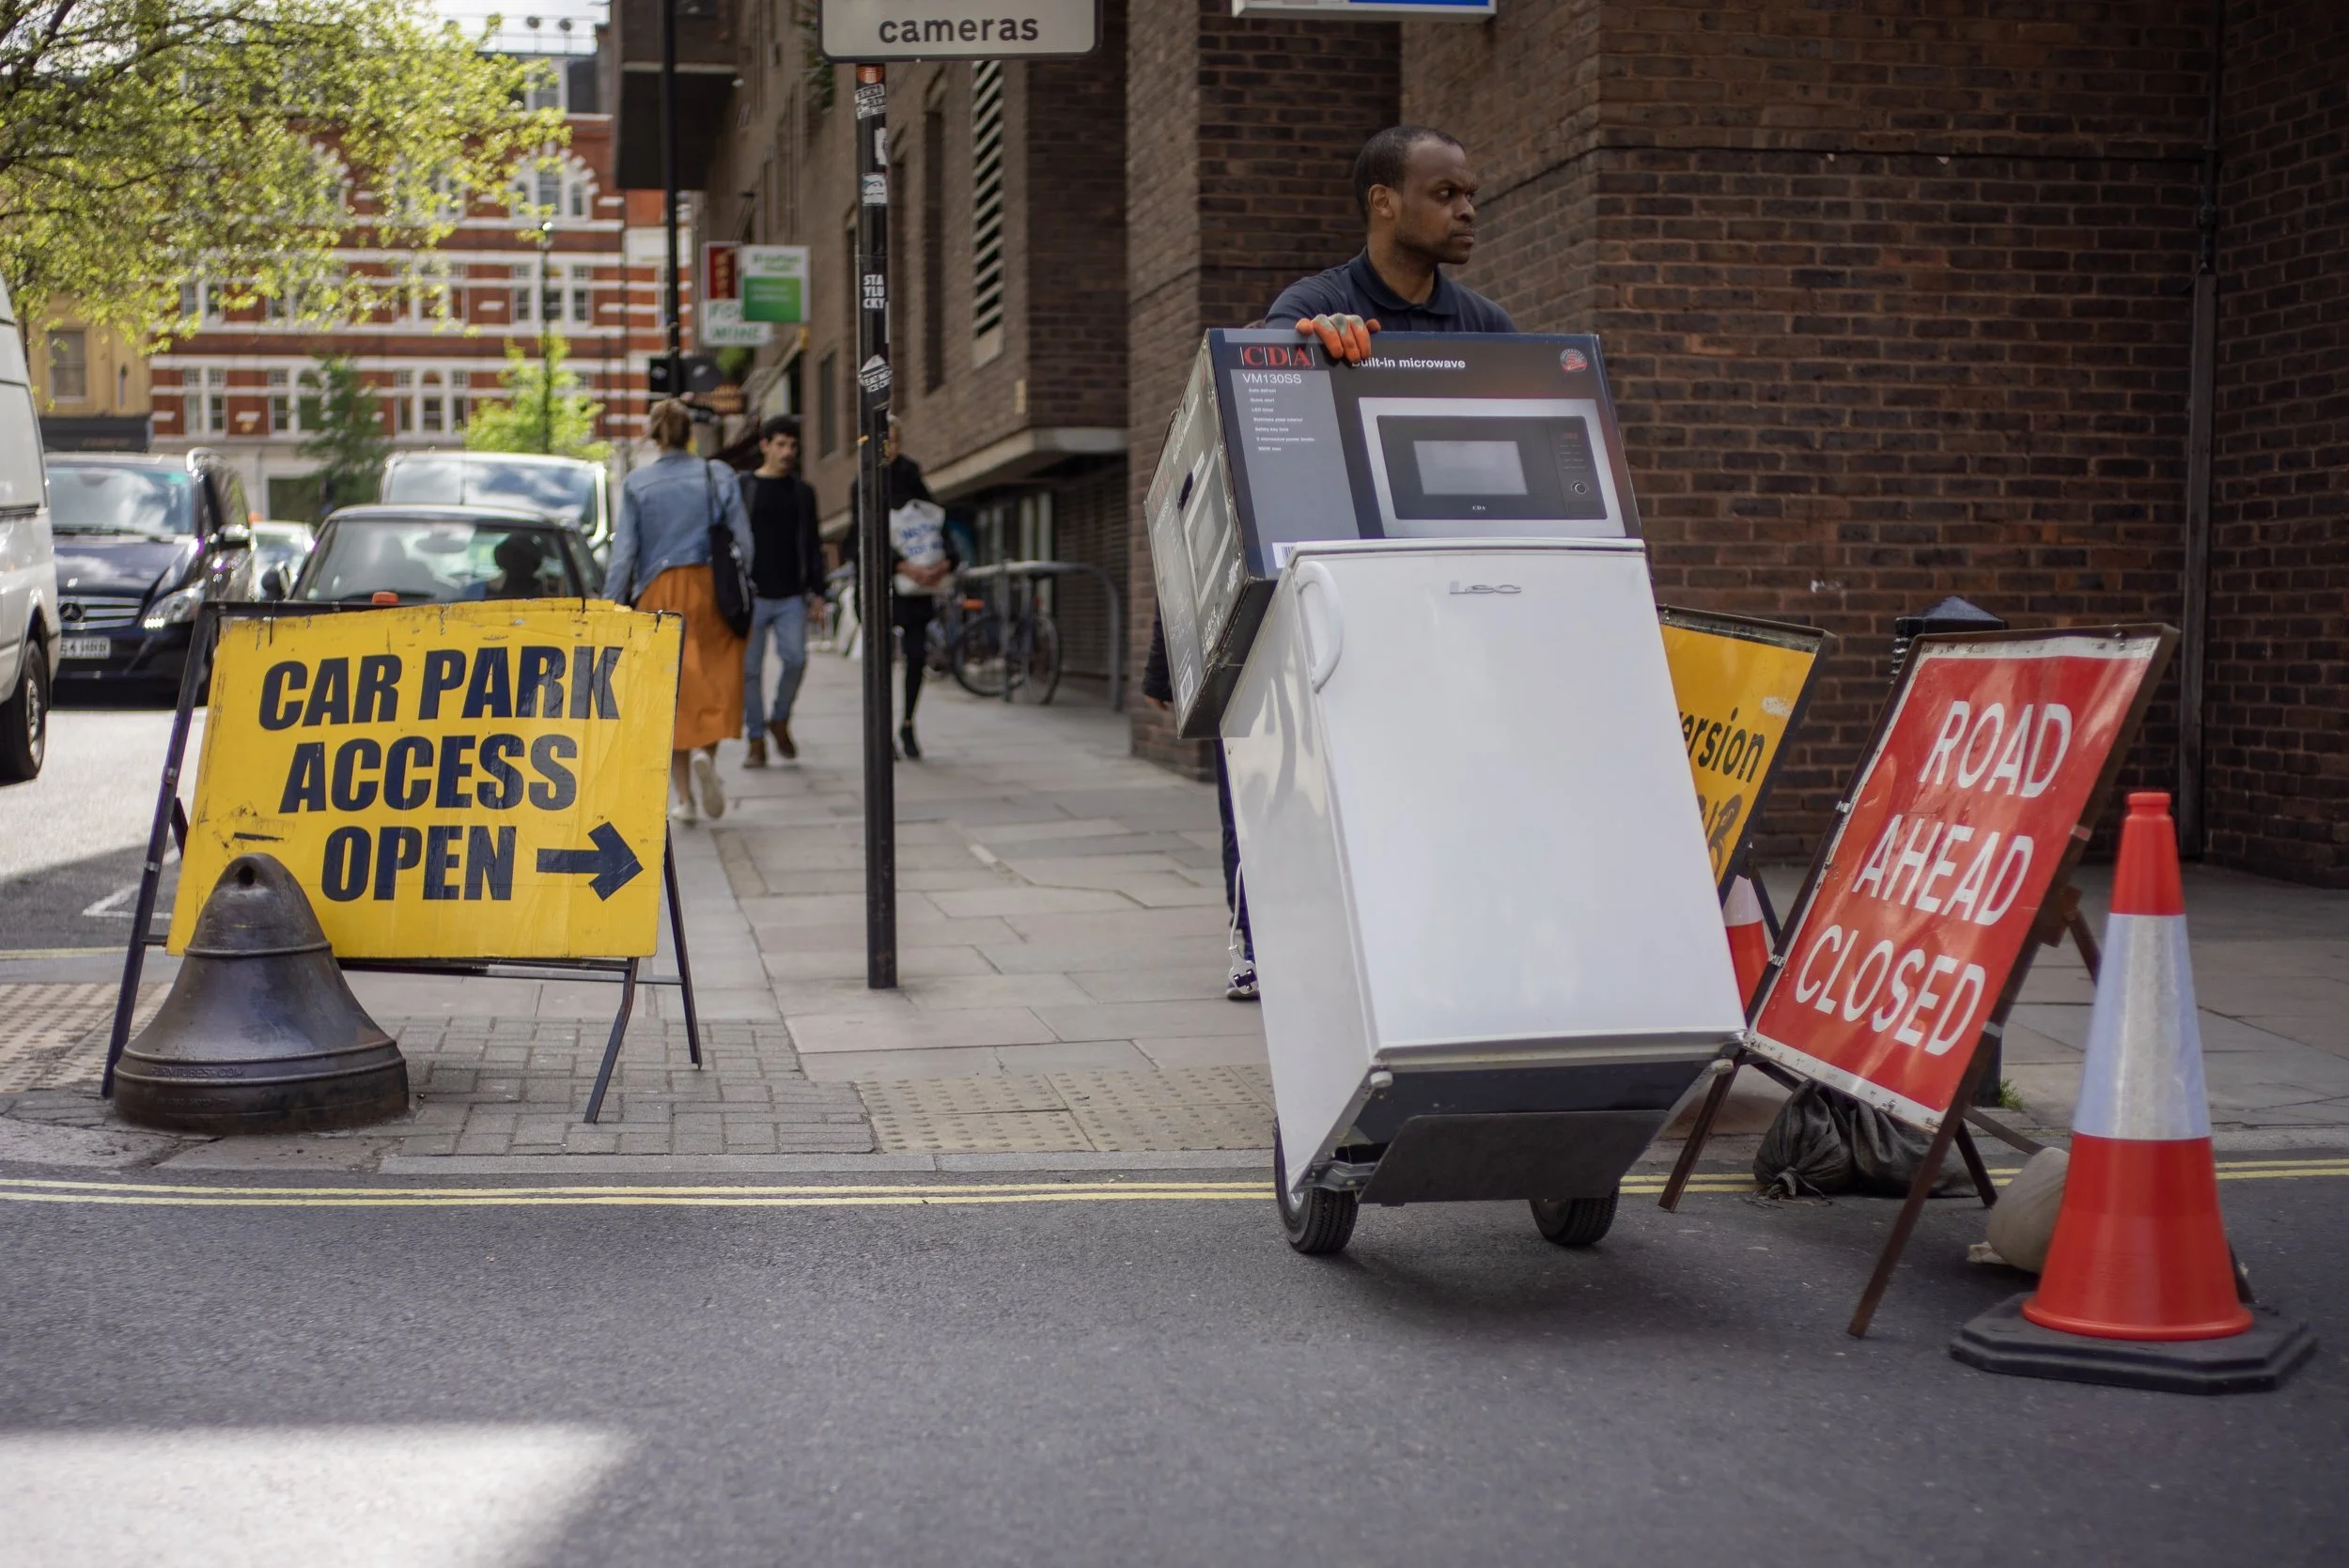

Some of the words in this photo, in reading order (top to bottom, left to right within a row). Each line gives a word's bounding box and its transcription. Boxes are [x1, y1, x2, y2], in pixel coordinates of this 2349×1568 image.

[879, 18, 1039, 43] cameras
[863, 297, 885, 309] CKY
[864, 274, 884, 286] STA
[1242, 373, 1302, 384] VM130SS
[1352, 357, 1396, 368] uilt-in
[1398, 358, 1466, 369] microwave
[258, 654, 403, 731] CAR
[417, 645, 624, 720] PARK
[278, 734, 578, 814] ACCESS
[1680, 706, 1766, 783] ersion
[1919, 700, 2073, 798] ROAD
[320, 825, 518, 902] OPEN
[1852, 815, 2034, 926] AHEAD
[1795, 924, 1985, 1056] CLOSED
